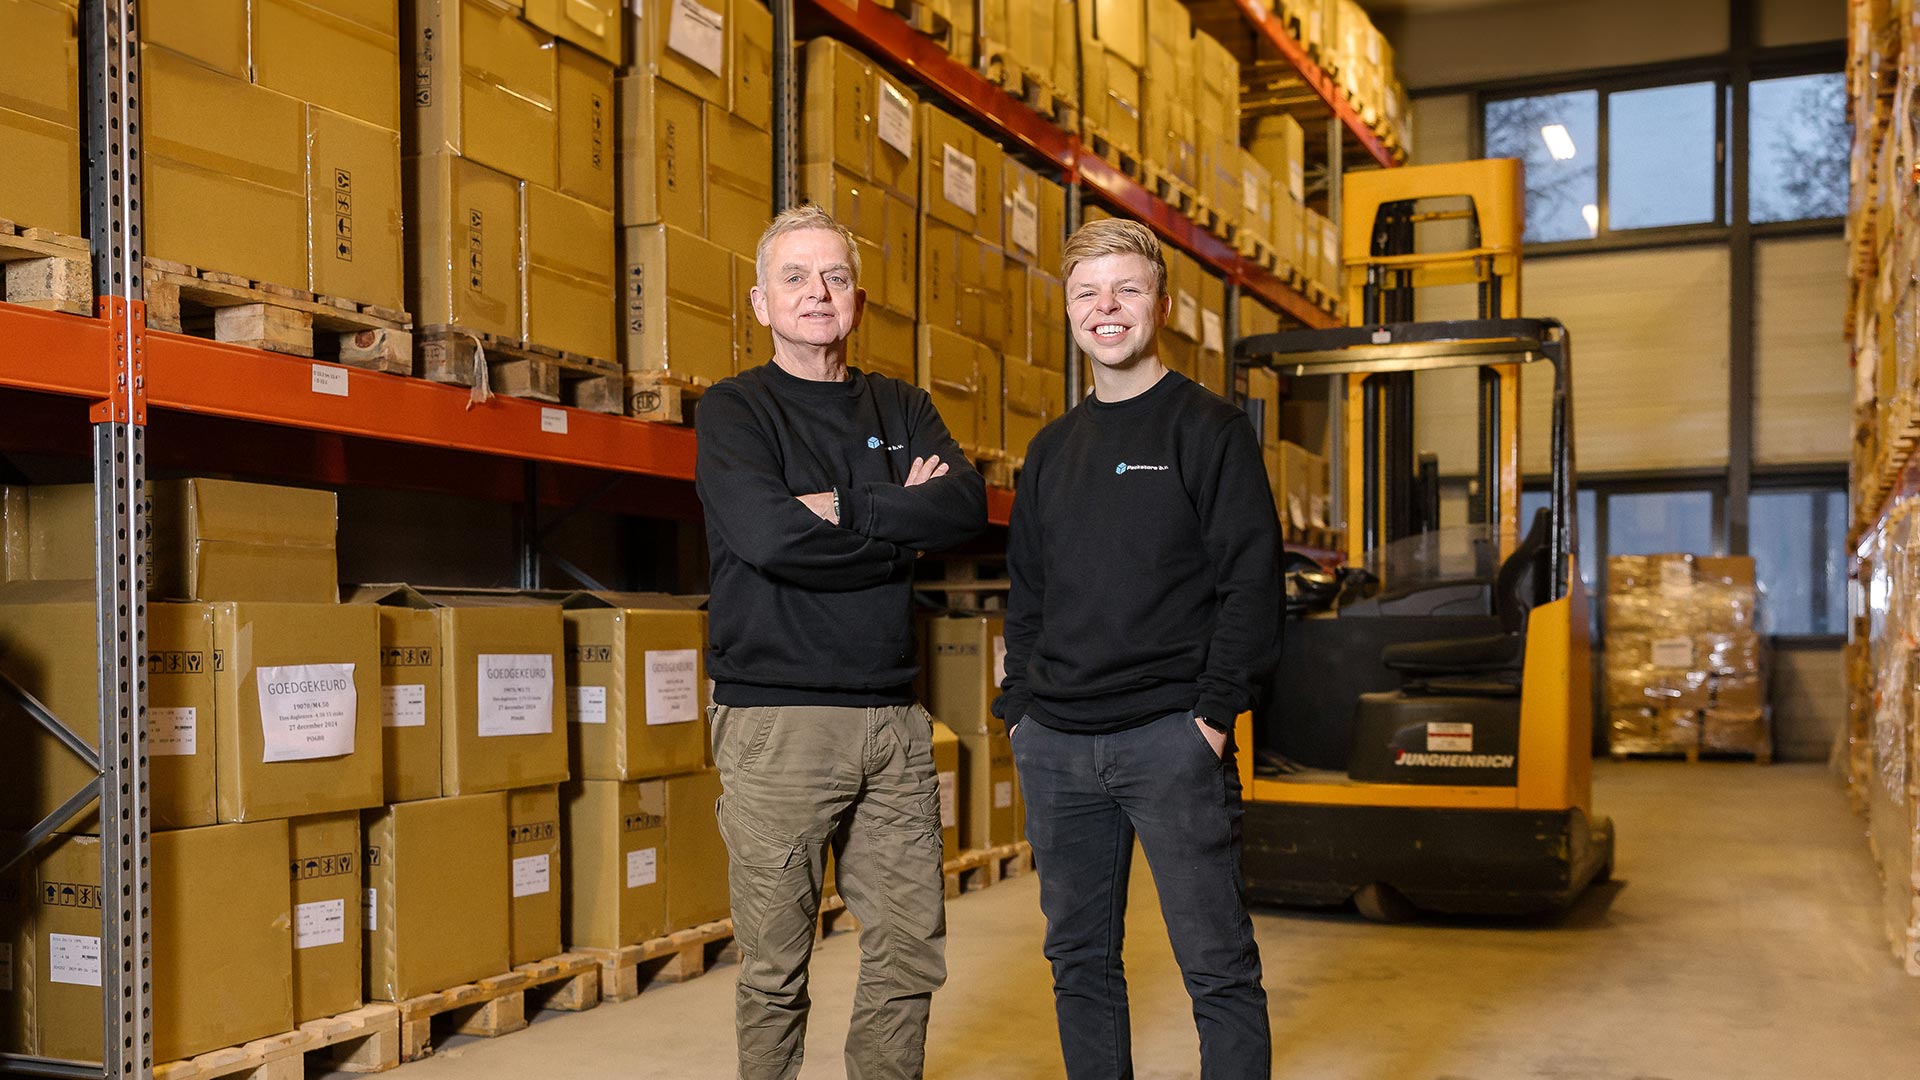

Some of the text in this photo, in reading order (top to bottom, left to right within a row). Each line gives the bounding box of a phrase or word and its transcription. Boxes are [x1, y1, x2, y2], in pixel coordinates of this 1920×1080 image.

[487, 668, 546, 680] GOEDGEKEURD
[267, 679, 347, 696] GOEDGEKEURD
[297, 723, 324, 731] december
[1394, 748, 1515, 768] JUNGHEINRICH
